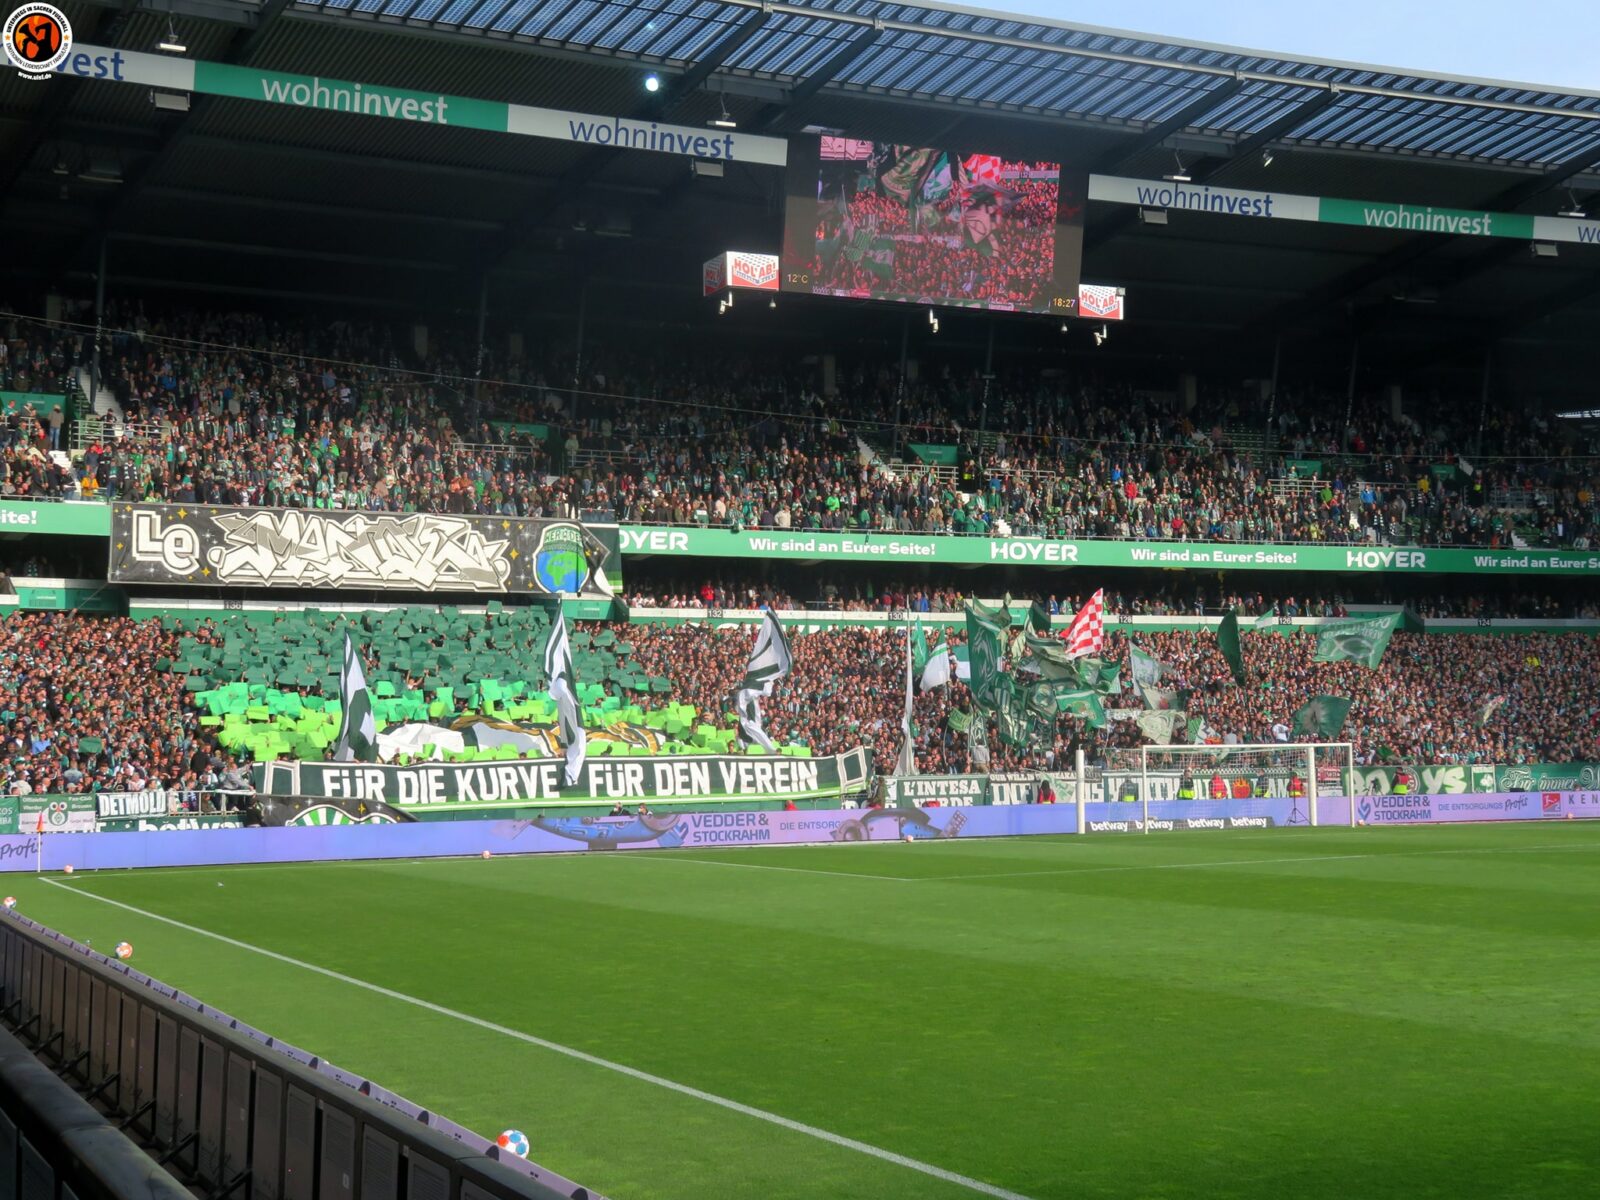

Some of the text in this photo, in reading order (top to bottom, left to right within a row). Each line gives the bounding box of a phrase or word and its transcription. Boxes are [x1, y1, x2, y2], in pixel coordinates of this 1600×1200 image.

[260, 77, 448, 125] wohninvest
[568, 117, 735, 160] wohninvest
[1137, 183, 1273, 218] wohninvest
[1363, 203, 1492, 236] wohninvest
[1053, 298, 1076, 308] 18:27
[132, 510, 200, 576] Le
[620, 530, 689, 551] OYER
[749, 538, 936, 556] Wir sind an Eurer Seite!
[991, 541, 1078, 562] HOYER
[1131, 549, 1297, 564] Wir sind an Eurer Seite!
[1347, 551, 1426, 568] HOYER
[1474, 556, 1498, 567] Wir
[1500, 556, 1528, 568] sind
[1531, 559, 1547, 568] an
[1550, 557, 1587, 568] Eurer
[708, 608, 722, 618] 132
[889, 611, 902, 620] 130
[323, 761, 818, 804] FÜR DIE KURVE FÜR DEN VEREIN
[903, 779, 981, 796] L'INTESA
[100, 792, 166, 816] DETMOLD
[912, 796, 974, 808] VRDE
[1373, 796, 1431, 808] VEDDER &
[1438, 803, 1449, 811] DIE
[1451, 802, 1504, 811] ENTSORGUNGS
[691, 813, 769, 828] VEDDER &
[1374, 809, 1431, 821] STOCKRAHM
[780, 822, 795, 831] DIE
[1089, 821, 1128, 832] betway
[1135, 819, 1174, 831] btway
[1187, 818, 1225, 830] betway
[1230, 817, 1267, 828] betway
[693, 829, 770, 843] STOCKRAHM
